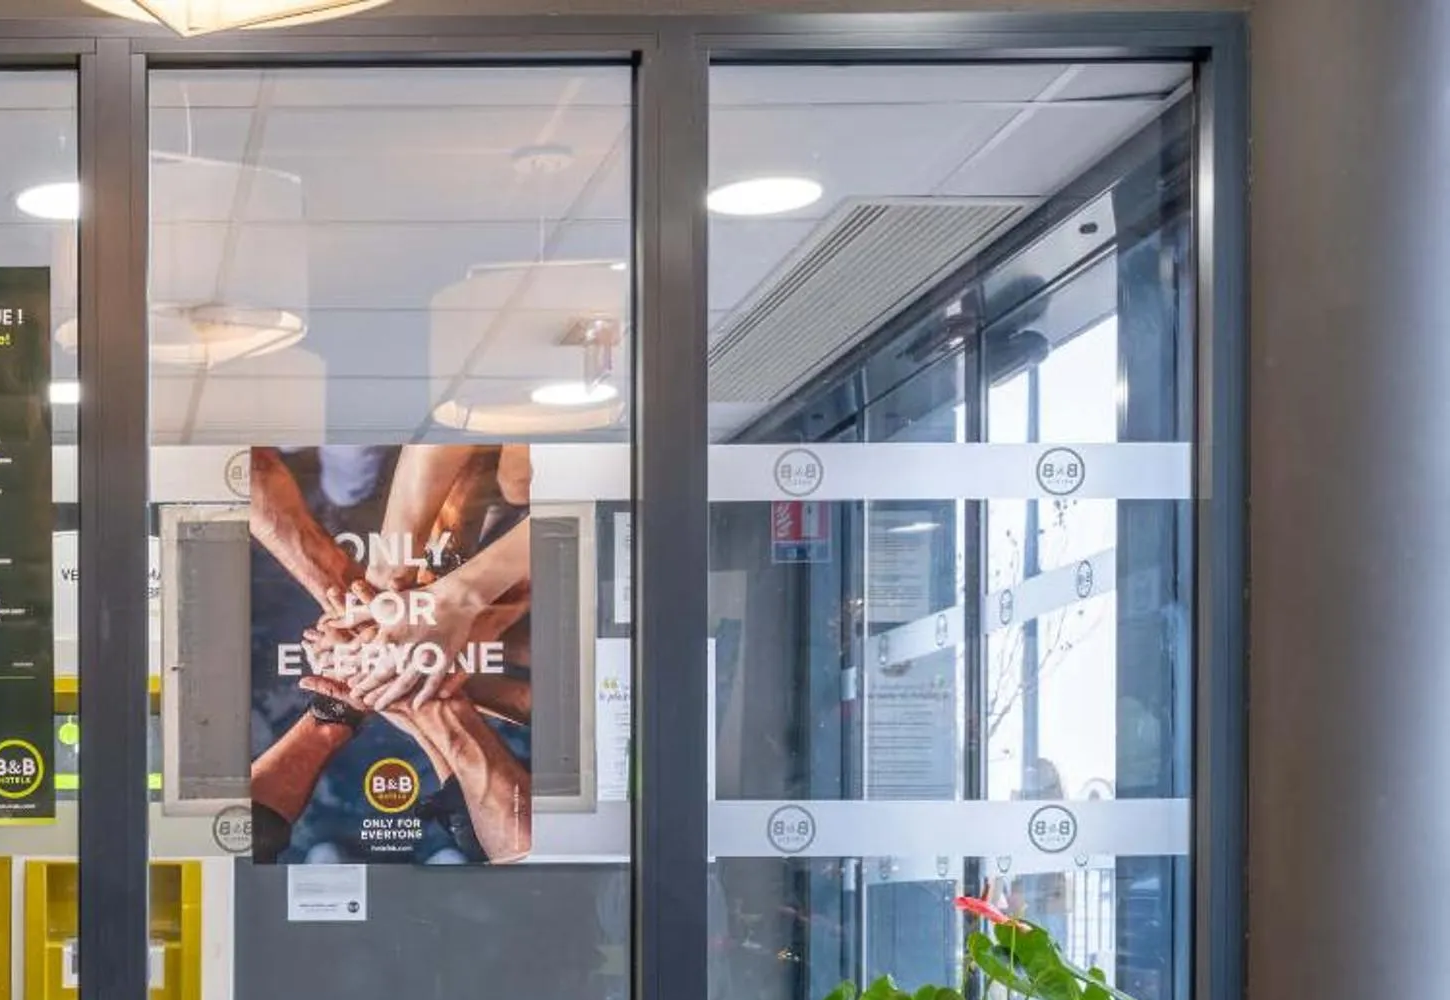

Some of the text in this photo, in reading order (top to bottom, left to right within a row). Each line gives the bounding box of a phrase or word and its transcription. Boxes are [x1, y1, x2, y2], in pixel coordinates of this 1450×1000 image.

[17, 308, 24, 325] !
[335, 530, 452, 568] ONLY
[344, 590, 438, 627] FOR
[277, 640, 505, 677] EVERYONE
[372, 775, 412, 794] B&B
[362, 818, 422, 829] ONLY FOR
[360, 829, 423, 841] EVERYONE
